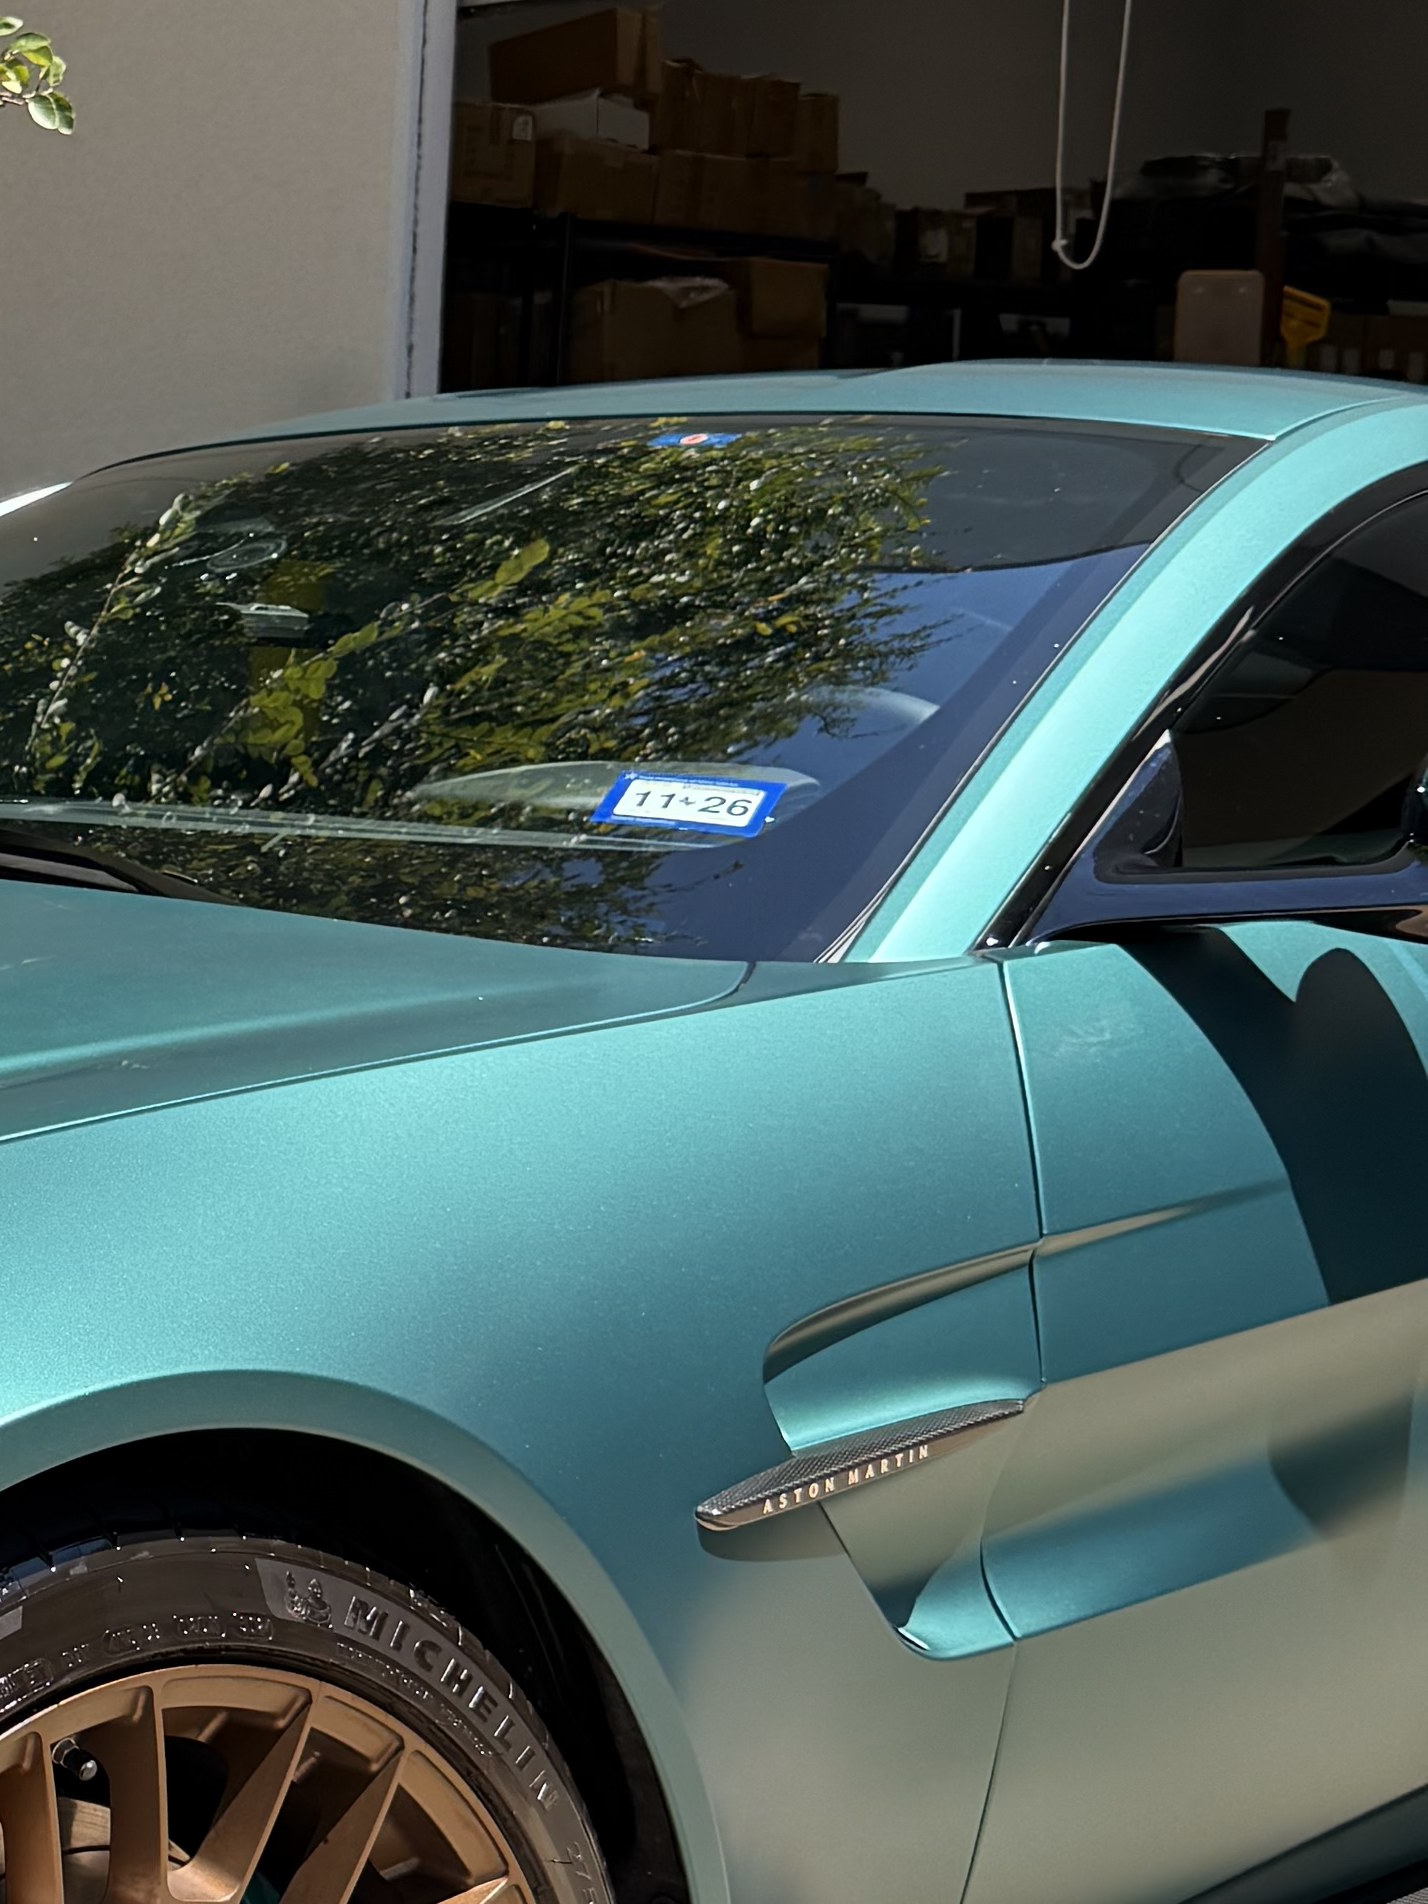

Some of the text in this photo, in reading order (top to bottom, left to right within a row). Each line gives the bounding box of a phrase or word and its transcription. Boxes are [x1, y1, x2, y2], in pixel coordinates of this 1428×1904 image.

[763, 1445, 930, 1514] ASTON MARTIN
[344, 1594, 560, 1812] MICHELIN
